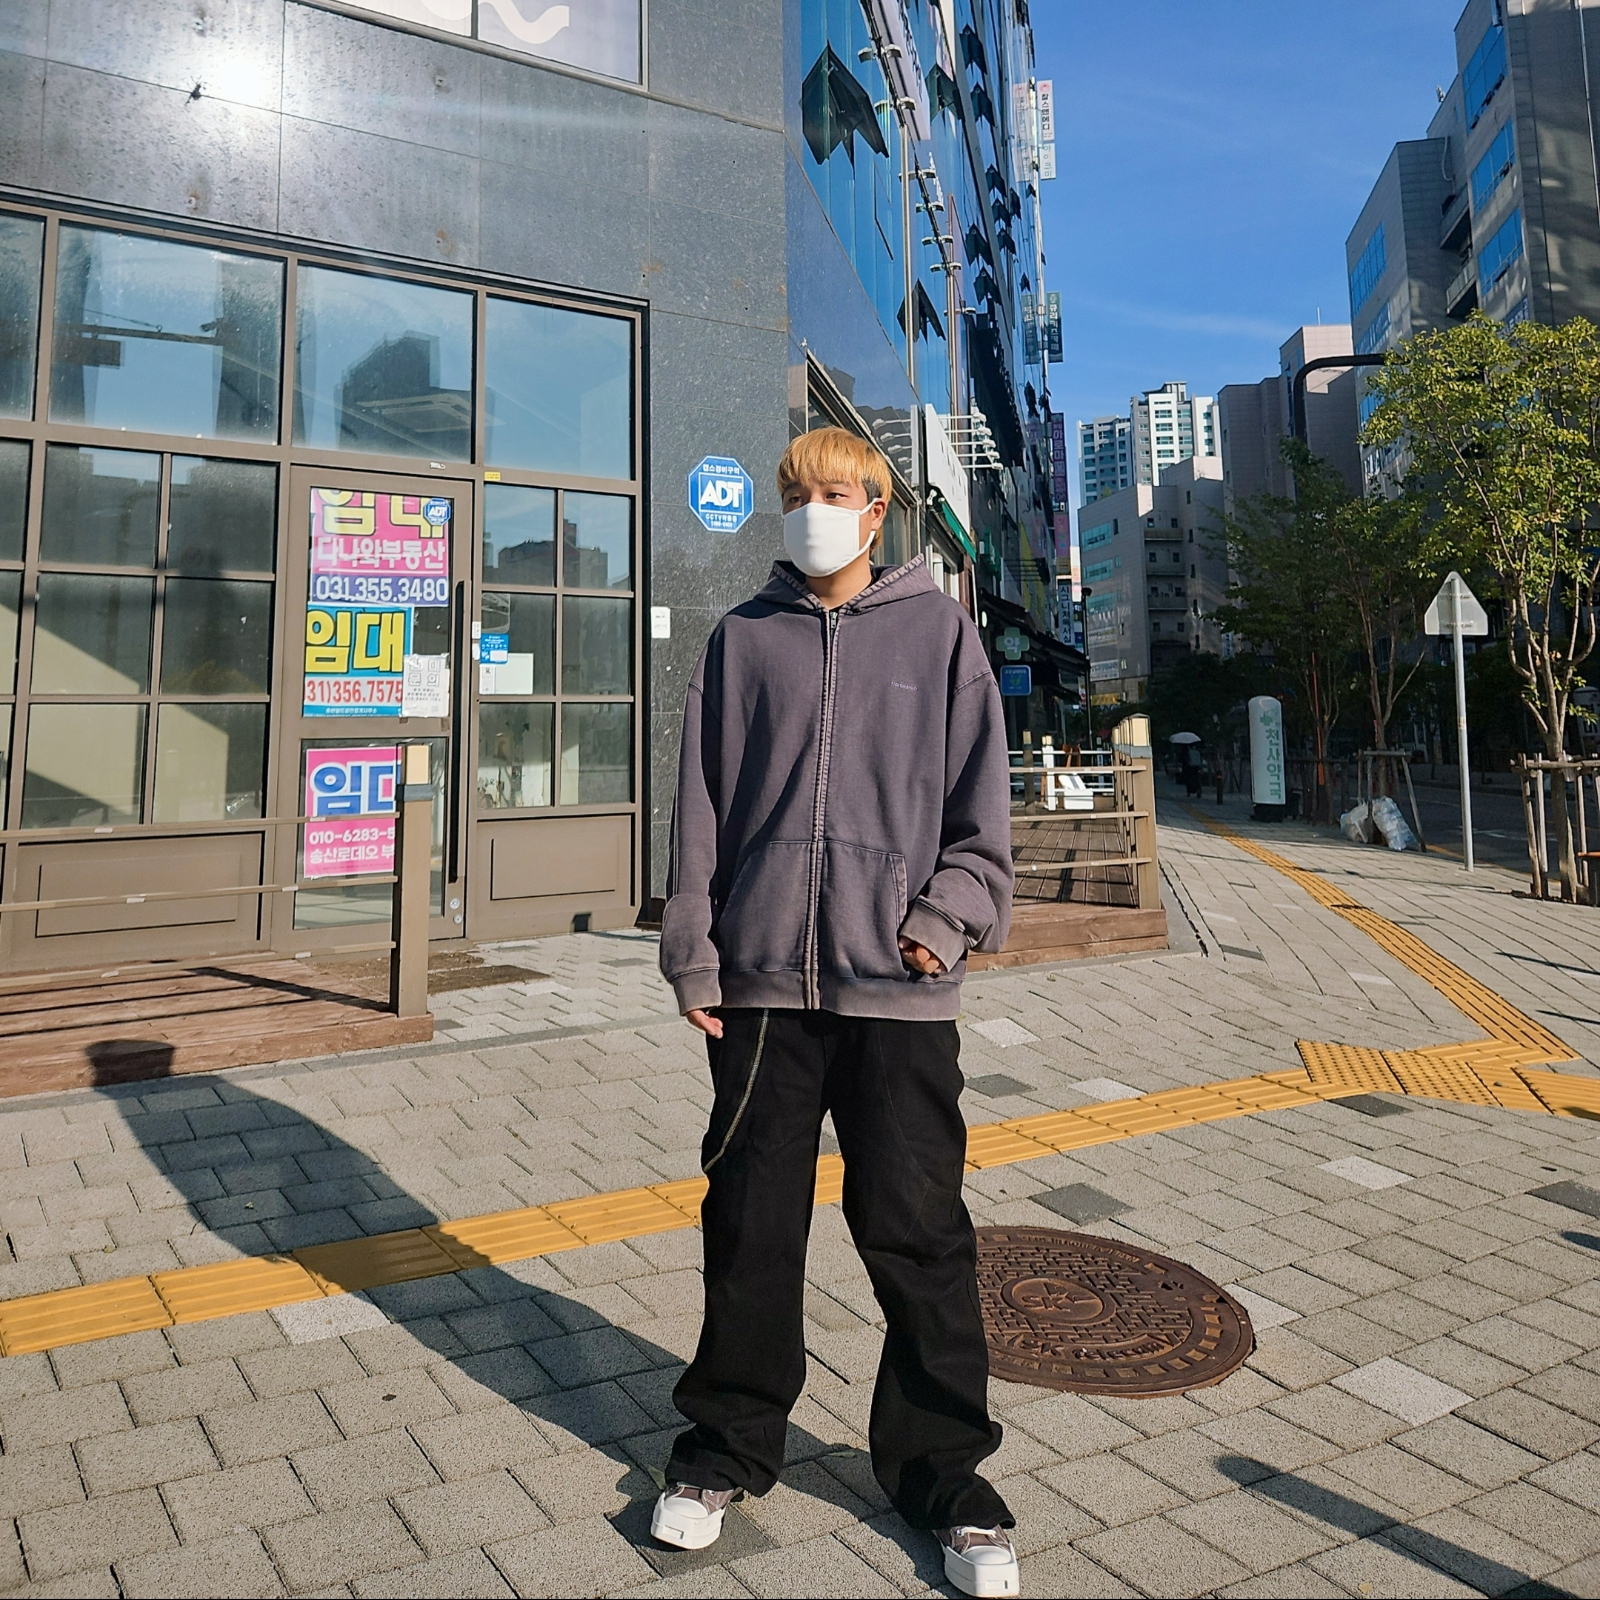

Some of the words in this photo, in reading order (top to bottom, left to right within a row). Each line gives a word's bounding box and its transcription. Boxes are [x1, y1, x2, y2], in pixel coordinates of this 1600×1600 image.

[700, 480, 743, 508] ADT
[428, 506, 448, 518] ADT
[317, 537, 445, 570] 다나와부동산
[316, 575, 449, 602] 031.355.3480
[305, 609, 405, 674] 임대
[1004, 637, 1020, 653] 약
[1266, 728, 1281, 799] 천사약국
[310, 844, 379, 865] 송산로데오
